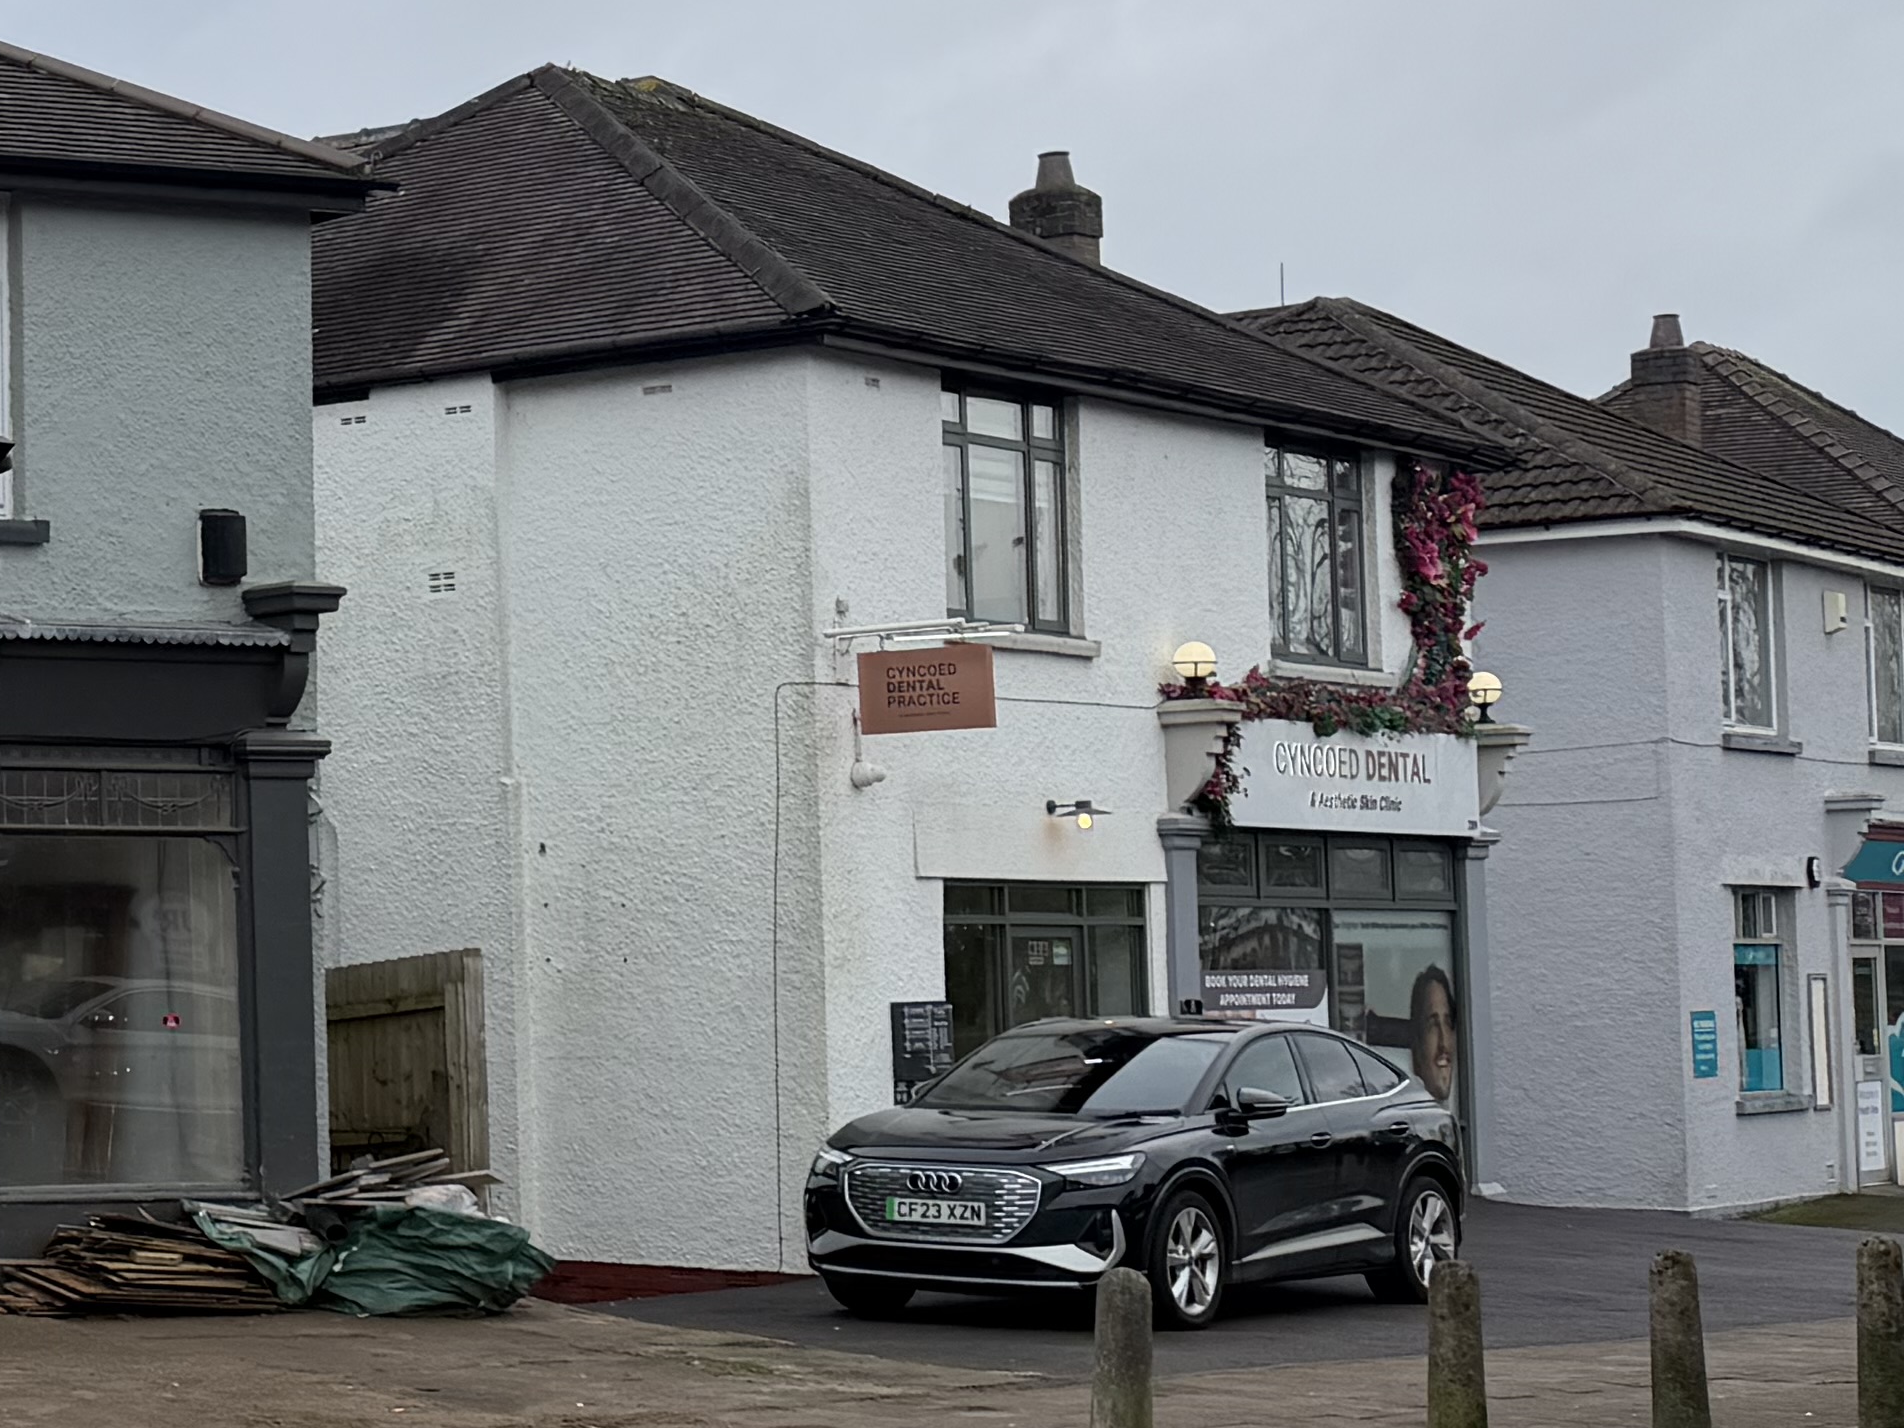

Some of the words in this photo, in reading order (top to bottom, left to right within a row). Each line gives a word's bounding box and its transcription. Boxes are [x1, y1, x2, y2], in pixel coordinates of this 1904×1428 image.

[886, 663, 957, 679] CYNCOED
[887, 678, 945, 693] DENTAL
[887, 691, 960, 708] PRACTICE
[1273, 741, 1360, 780] CYNCOED
[1364, 749, 1432, 785] DENTAL
[1318, 792, 1357, 810] Aesthetic
[1359, 794, 1378, 811] Skin
[1379, 795, 1402, 812] Clinic
[1205, 974, 1226, 988] BOOK
[1227, 974, 1248, 988] YOUR
[1249, 974, 1277, 988] DENTAL
[1277, 974, 1309, 987] HYGIENE
[1219, 993, 1270, 1006] APPOINTMENT
[1272, 992, 1295, 1005] TODAY
[897, 1201, 942, 1219] CF23
[947, 1203, 982, 1221] XZN
